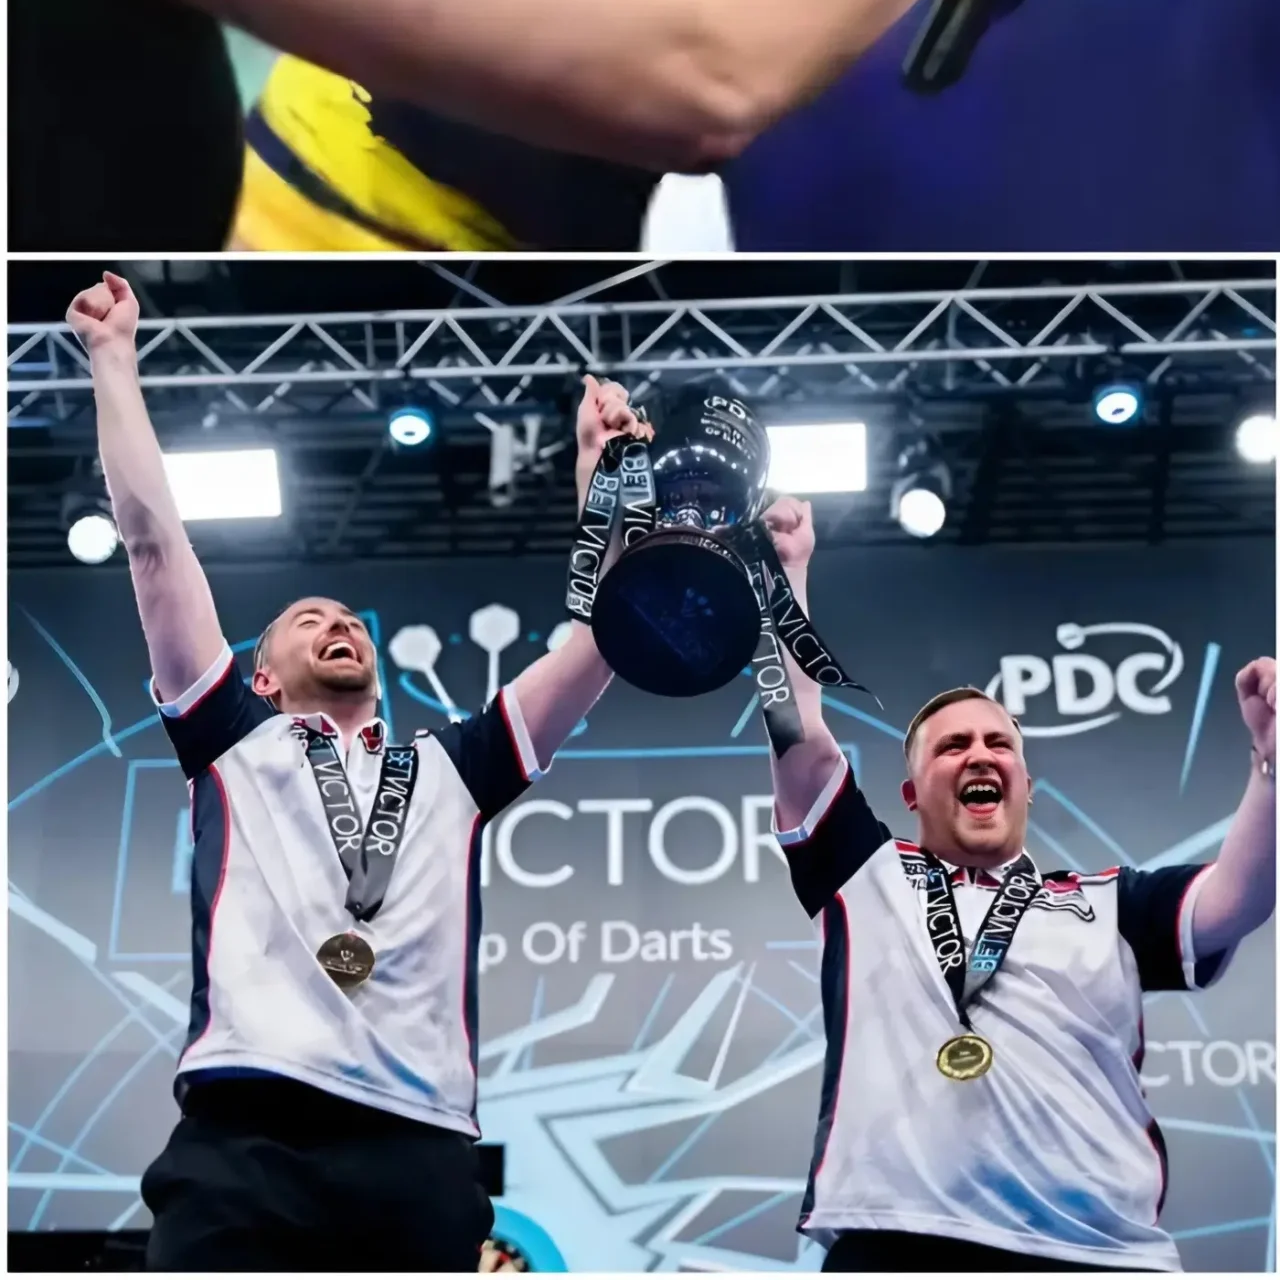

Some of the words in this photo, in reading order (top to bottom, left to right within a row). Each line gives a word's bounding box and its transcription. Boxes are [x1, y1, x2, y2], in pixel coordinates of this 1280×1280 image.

[1000, 653, 1172, 717] PDC
[521, 920, 588, 963] Of
[601, 920, 733, 963] Darts
